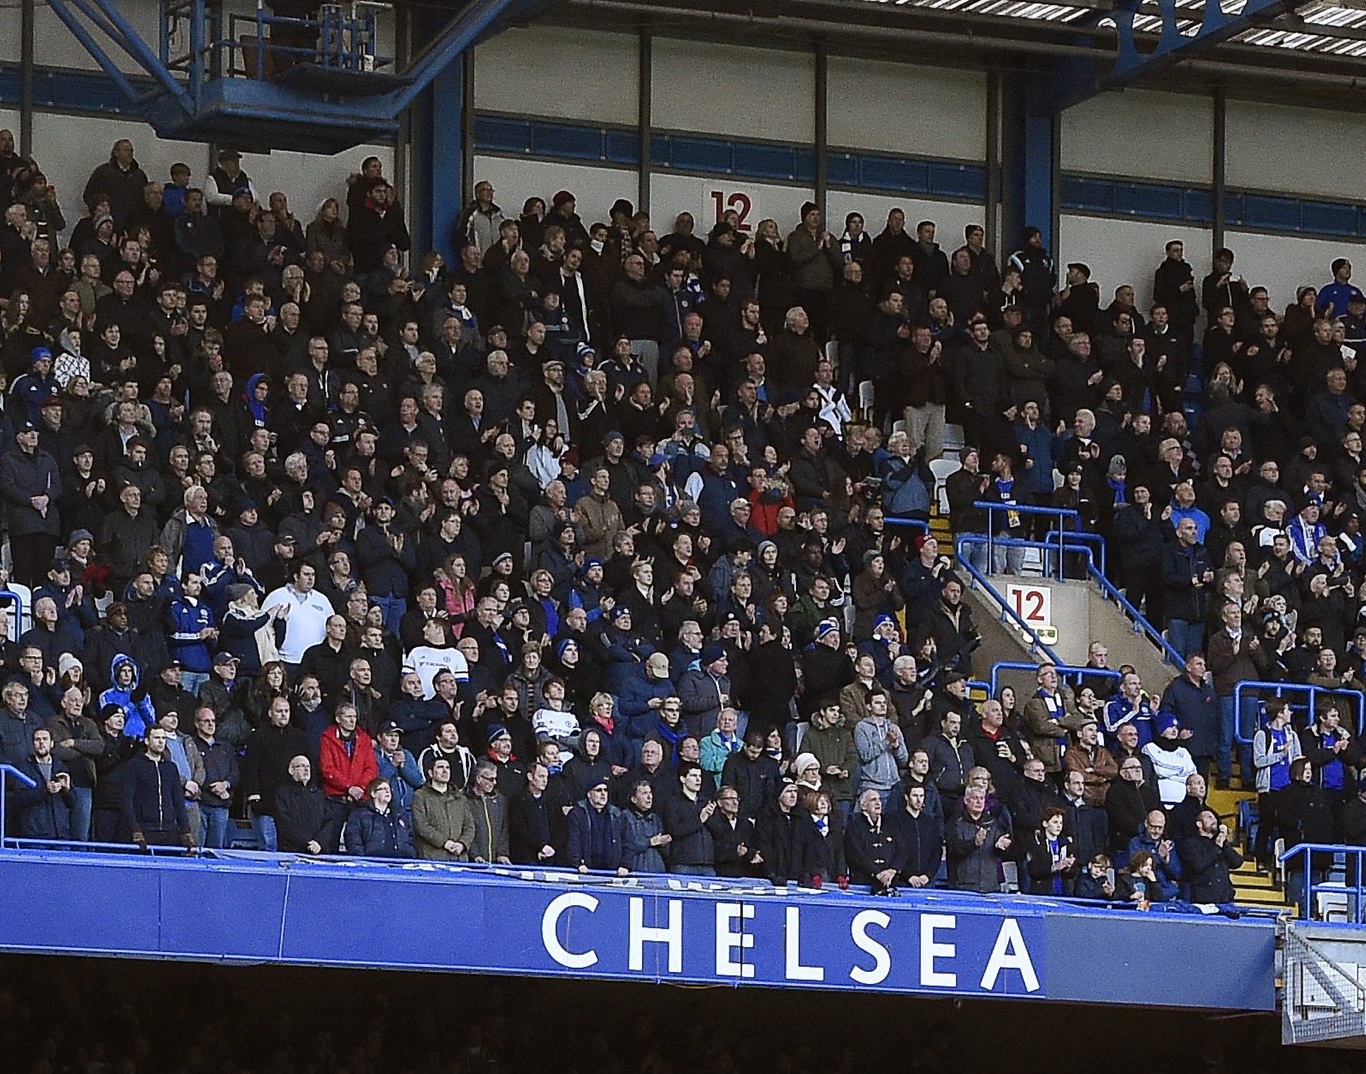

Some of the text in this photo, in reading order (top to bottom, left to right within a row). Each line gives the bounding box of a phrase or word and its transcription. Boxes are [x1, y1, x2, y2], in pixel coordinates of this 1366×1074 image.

[711, 190, 751, 231] 12
[1012, 589, 1045, 621] 12
[541, 892, 1041, 993] CHELSEA
